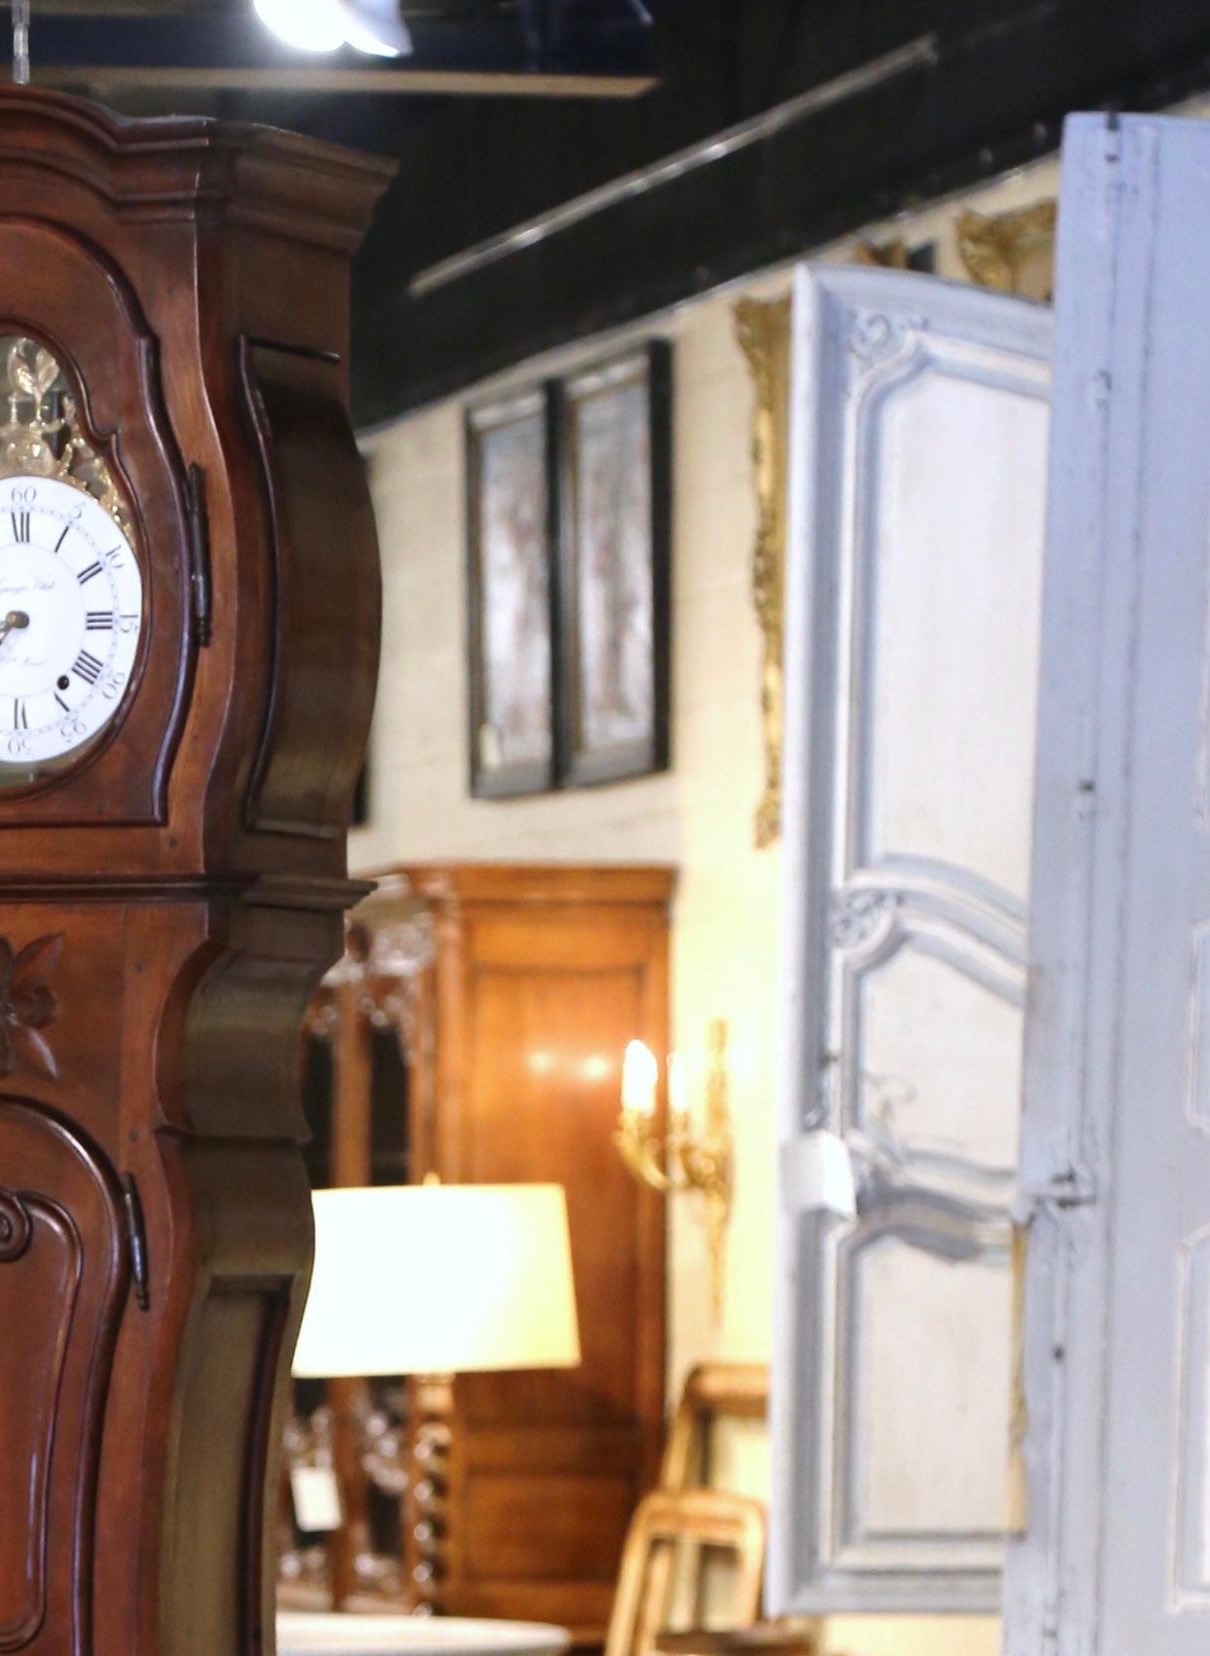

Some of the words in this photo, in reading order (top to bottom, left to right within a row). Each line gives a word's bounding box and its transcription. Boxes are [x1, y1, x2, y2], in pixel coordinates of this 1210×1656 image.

[11, 486, 37, 505] 60
[105, 543, 126, 569] 10
[76, 560, 104, 585] II
[86, 611, 113, 631] III
[71, 648, 104, 686] IIII
